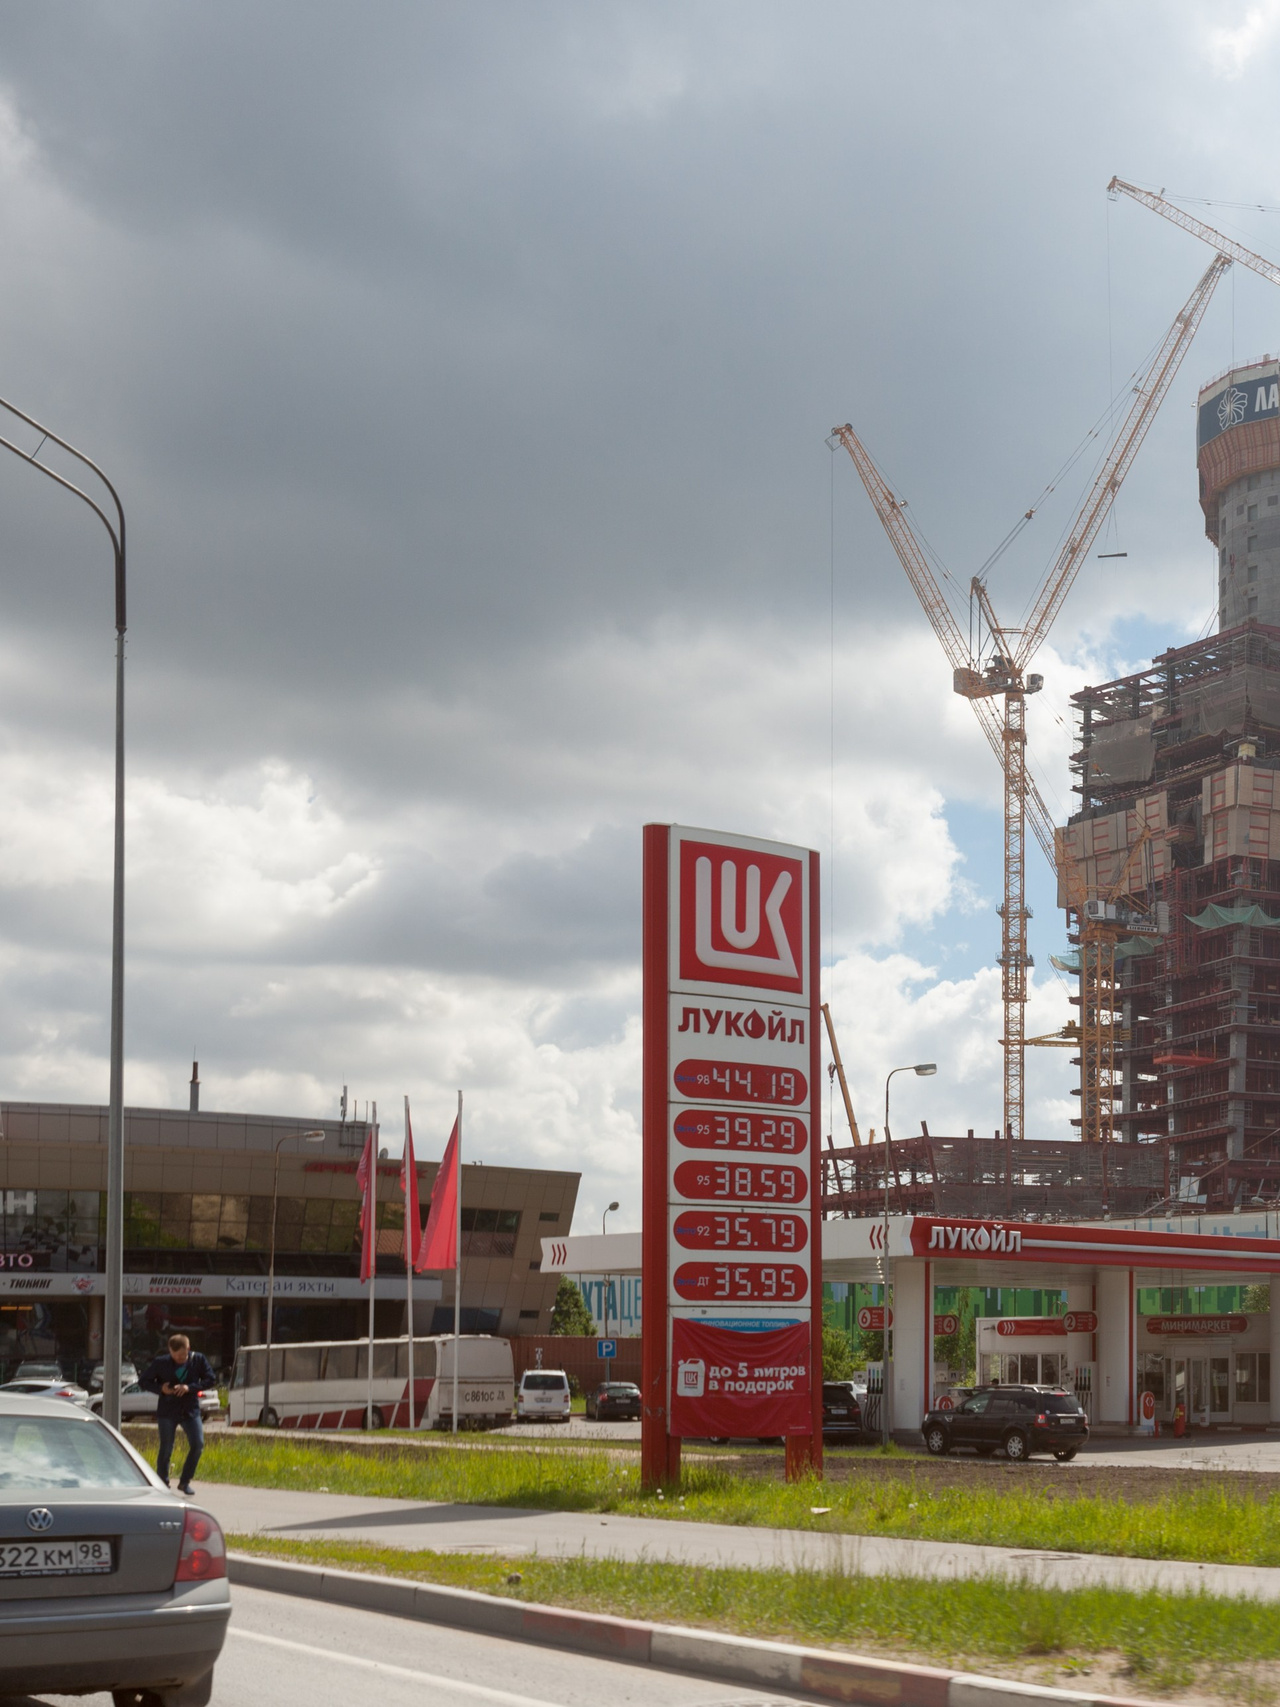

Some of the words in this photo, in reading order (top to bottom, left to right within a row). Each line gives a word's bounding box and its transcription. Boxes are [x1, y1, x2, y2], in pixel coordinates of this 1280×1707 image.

[678, 1007, 805, 1044] ЛУКОЙЛ
[696, 1074, 710, 1085] 98
[712, 1067, 795, 1101] 44.19
[696, 1124, 710, 1135] 95
[714, 1116, 795, 1149] 39.29
[696, 1175, 711, 1186] 95
[714, 1166, 795, 1199] 38.59
[0, 1190, 35, 1215] Н
[696, 1226, 710, 1237] 92
[714, 1216, 795, 1248] 35.79
[928, 1224, 1021, 1253] ЛУКОЙЛ
[150, 1277, 203, 1286] МОТОБЛОКИ
[225, 1277, 281, 1295] Катера
[284, 1280, 293, 1291] и
[298, 1280, 335, 1293] яхты
[697, 1276, 710, 1287] ДТ
[714, 1267, 795, 1297] 35.95
[1161, 1321, 1231, 1331] МИНИМАРКЕТ
[602, 1341, 613, 1357] P
[709, 1366, 732, 1379] до
[738, 1362, 748, 1377] 5
[753, 1366, 806, 1380] литров
[708, 1380, 719, 1391] в
[724, 1380, 794, 1395] подарок
[80, 1543, 102, 1559] 98
